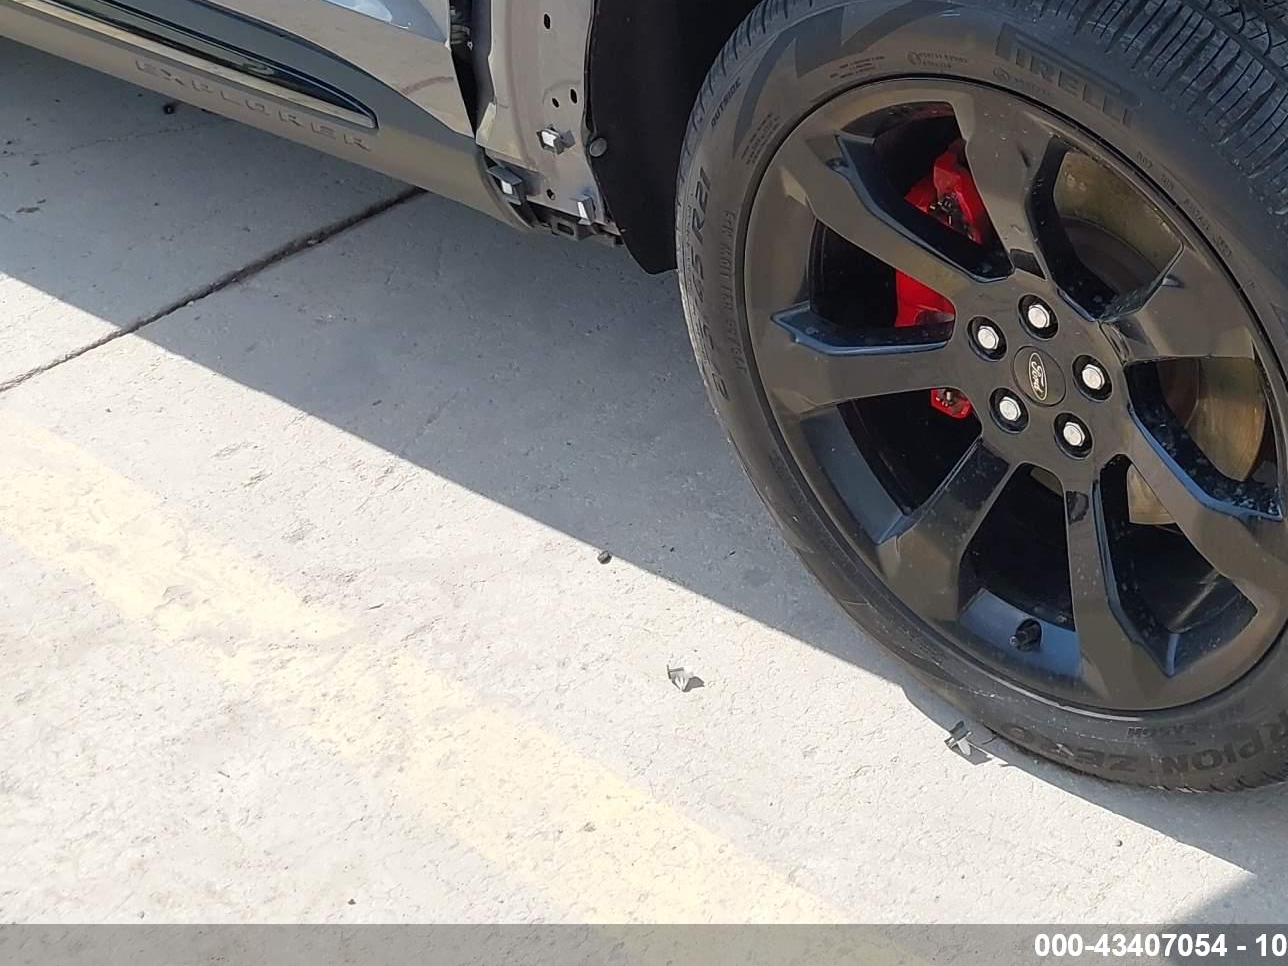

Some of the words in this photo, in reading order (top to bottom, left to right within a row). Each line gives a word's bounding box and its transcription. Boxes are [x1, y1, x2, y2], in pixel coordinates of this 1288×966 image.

[134, 58, 372, 152] EXPLORER
[711, 77, 743, 127] OUTSIDE
[691, 167, 711, 244] R21
